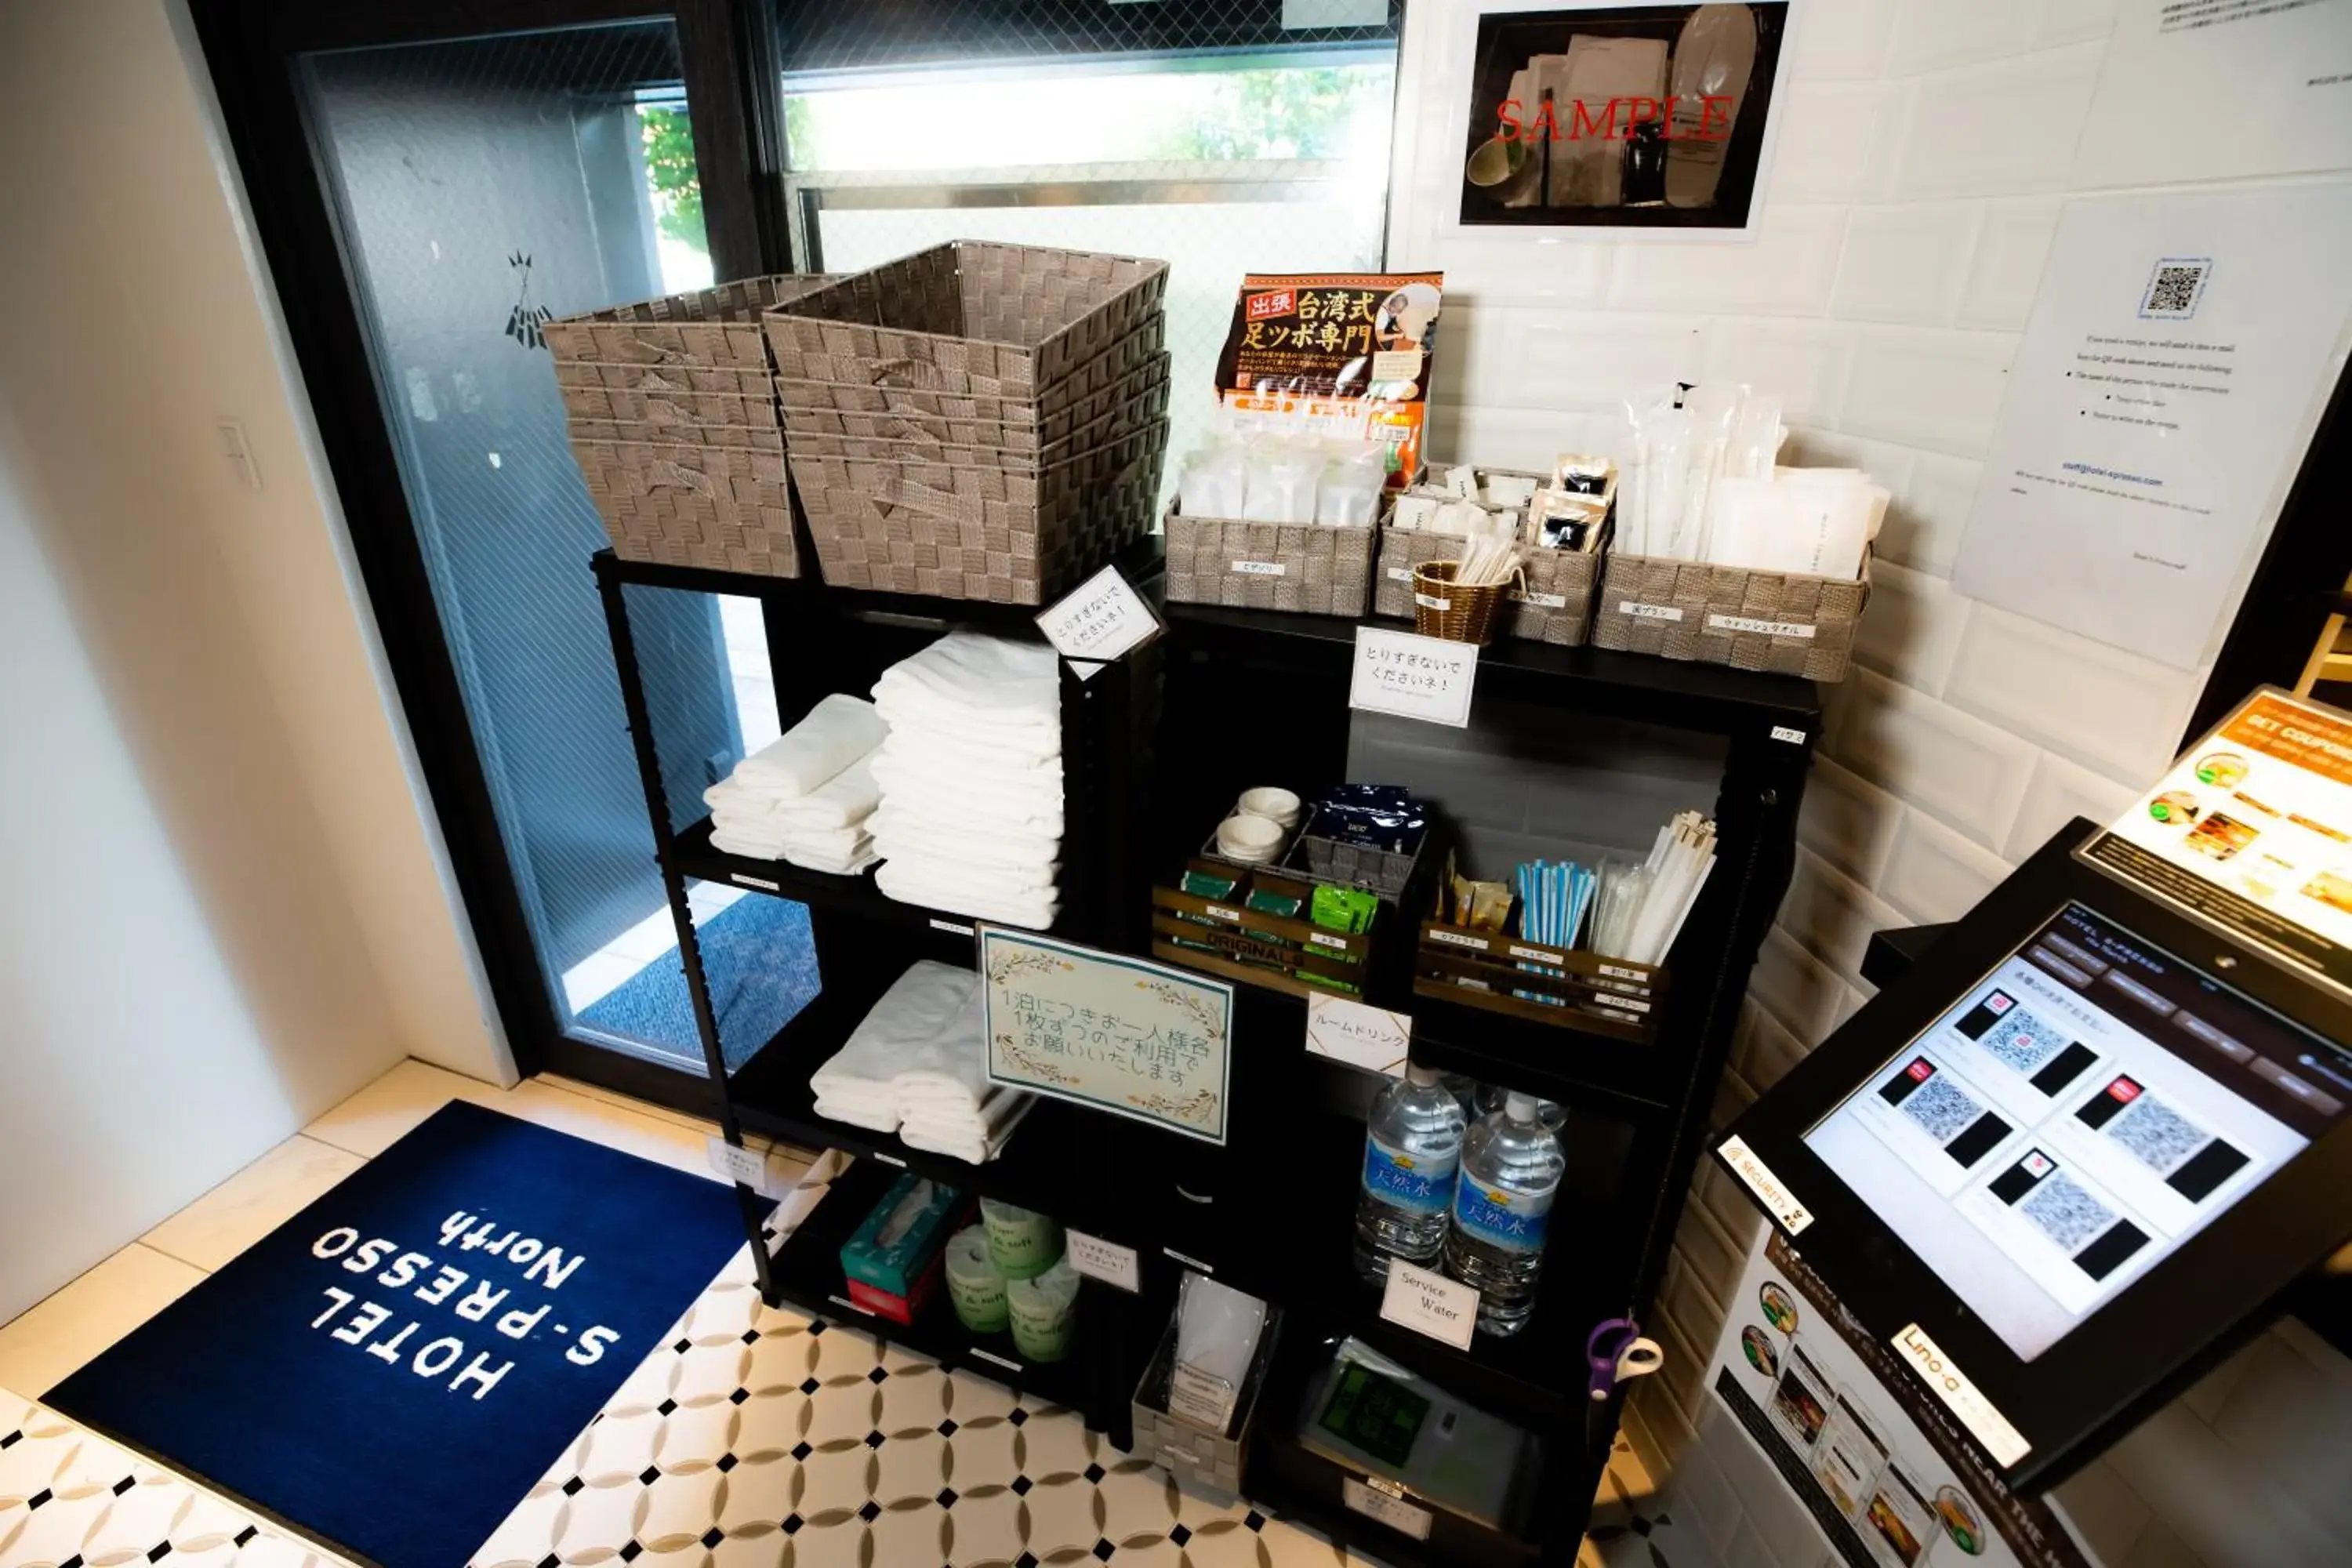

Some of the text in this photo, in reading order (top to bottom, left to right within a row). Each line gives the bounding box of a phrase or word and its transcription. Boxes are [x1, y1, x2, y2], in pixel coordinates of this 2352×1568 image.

[1494, 95, 1734, 143] SAMPLE
[1251, 291, 1375, 323] 出張 台湾式
[1240, 321, 1372, 354] 足ツボ専門
[1367, 646, 1461, 674] とりすぎないで
[1316, 1014, 1405, 1047] ルームドリンク
[1024, 1032, 1185, 1087] お願いいたします
[1376, 1169, 1431, 1197] 天然水
[1468, 1204, 1526, 1236] 天然水
[437, 1210, 586, 1290] North
[1401, 1272, 1446, 1298] Service
[1421, 1296, 1460, 1321] Water
[310, 1286, 515, 1402] HOTEL
